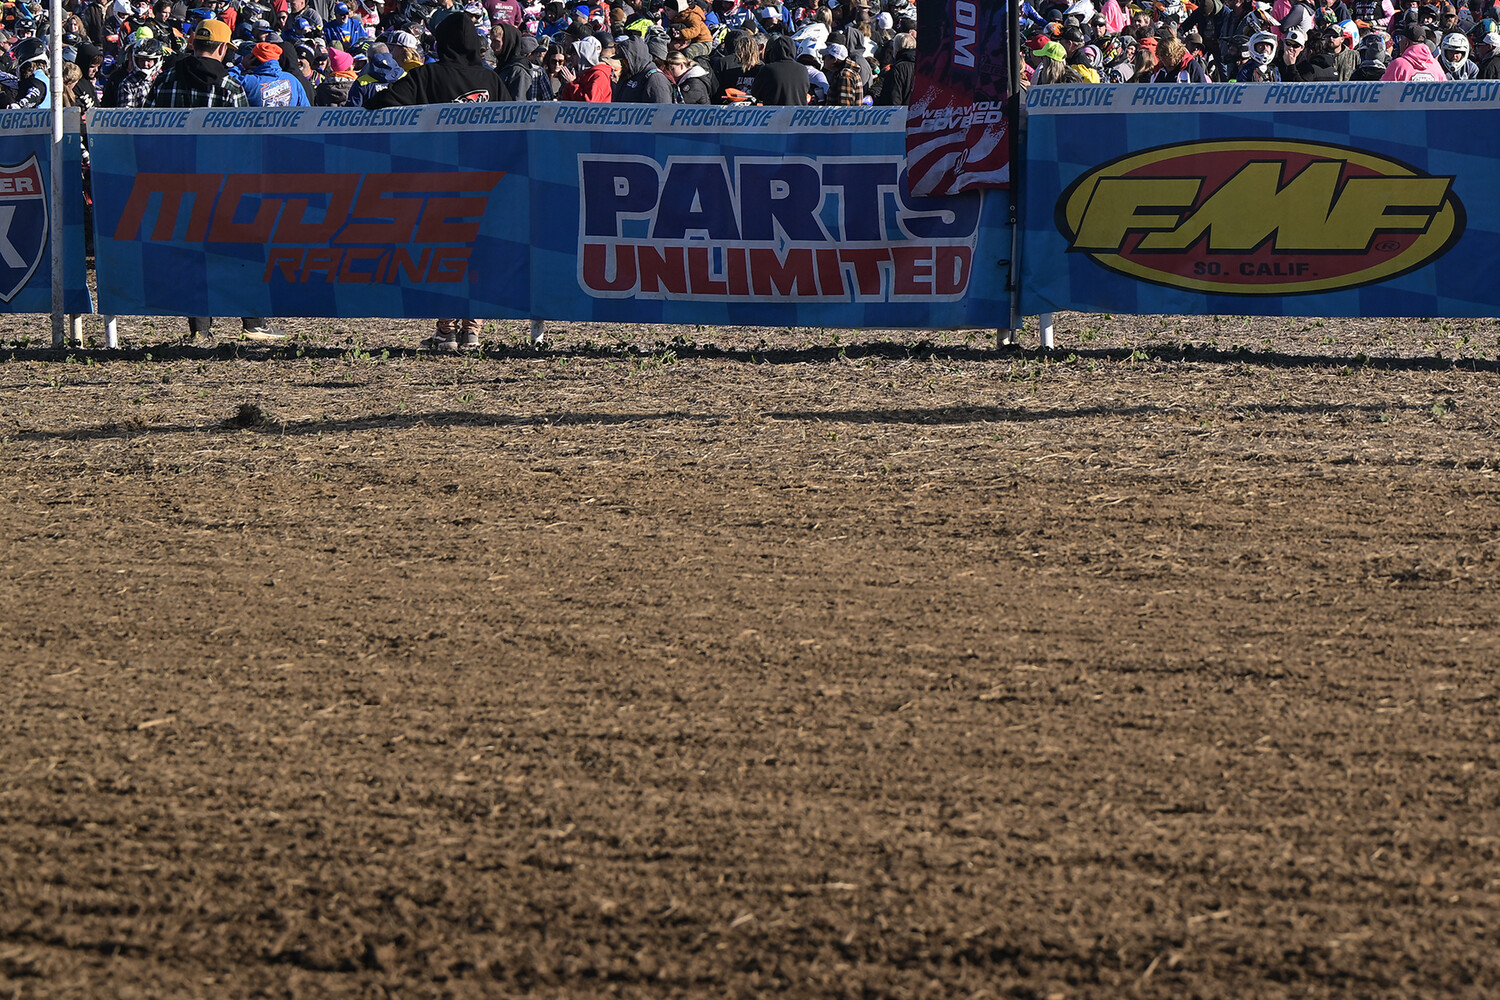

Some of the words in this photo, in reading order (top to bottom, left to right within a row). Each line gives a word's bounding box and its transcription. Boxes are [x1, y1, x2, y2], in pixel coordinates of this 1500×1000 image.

[972, 101, 1002, 111] YOU
[1026, 87, 1115, 108] OGRESSIVE
[1131, 85, 1247, 105] PROGRESSIVE
[1264, 84, 1381, 104] PROGRESSIVE
[91, 109, 188, 128] PROGRESSIVE
[202, 108, 302, 128] PROGRESSIVE
[318, 107, 420, 127] PROGRESSIVE
[436, 105, 540, 125] PROGRESSIVE
[554, 105, 657, 126] PROGRESSIVE
[671, 107, 775, 127] PROGRESSIVE
[790, 106, 893, 126] PROGRESSIVE
[113, 171, 506, 244] MOOSE
[580, 158, 983, 240] PARTS
[1066, 159, 1456, 254] FMF
[263, 247, 473, 285] RACING
[580, 243, 973, 297] UNLIMITED
[1193, 261, 1230, 276] SO.
[1239, 262, 1319, 277] CALIF.
